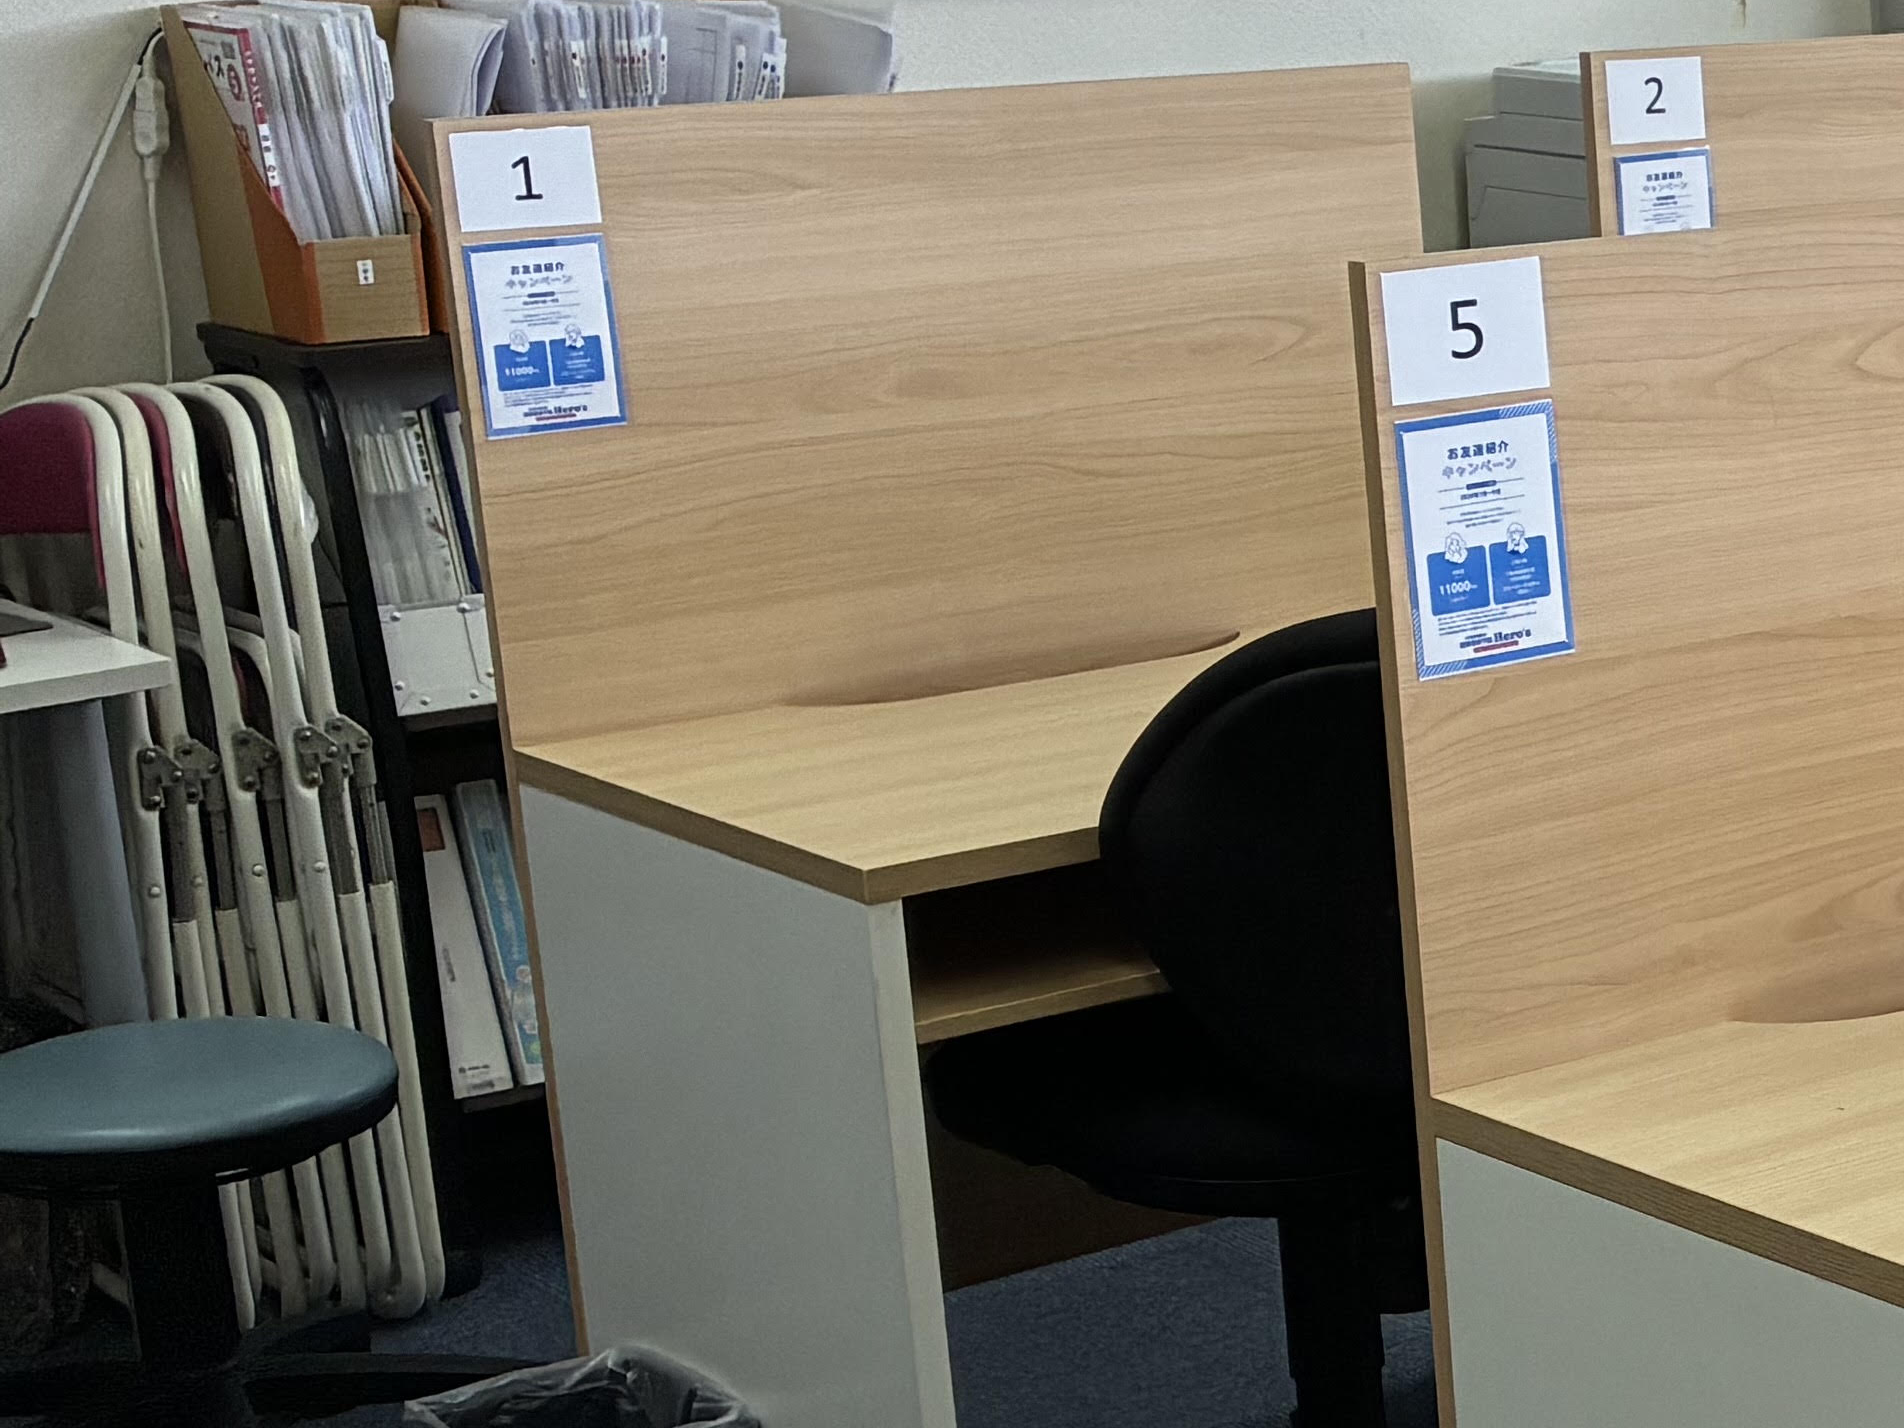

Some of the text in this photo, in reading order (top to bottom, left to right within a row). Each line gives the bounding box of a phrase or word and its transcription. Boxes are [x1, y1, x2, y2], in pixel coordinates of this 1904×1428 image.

[1644, 76, 1667, 115] 2
[511, 155, 544, 201] 1
[1450, 298, 1484, 360] 5
